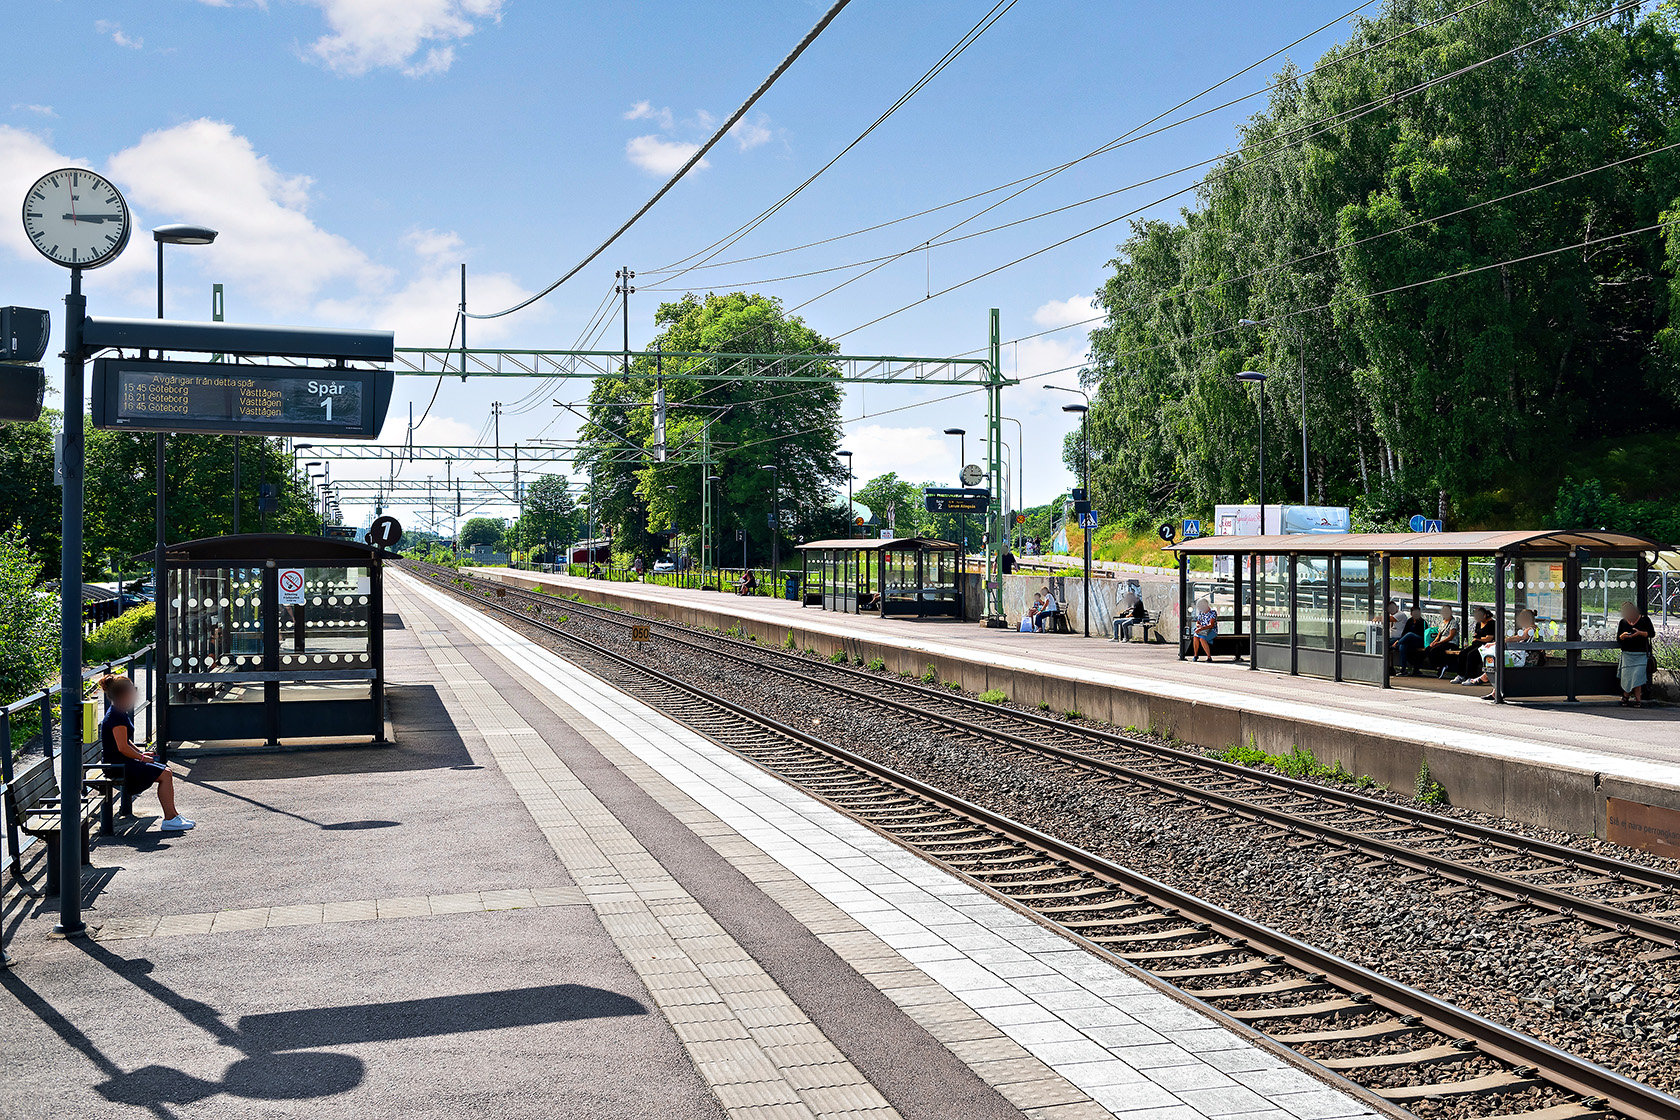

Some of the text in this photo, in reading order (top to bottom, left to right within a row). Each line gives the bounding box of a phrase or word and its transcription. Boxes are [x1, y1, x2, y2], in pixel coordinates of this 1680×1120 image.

[213, 378, 236, 387] detta
[307, 380, 345, 397] Spår
[320, 396, 332, 421] 1
[381, 521, 391, 540] 1
[1163, 526, 1173, 538] 2
[798, 535, 804, 543] 2
[633, 628, 649, 639] 050
